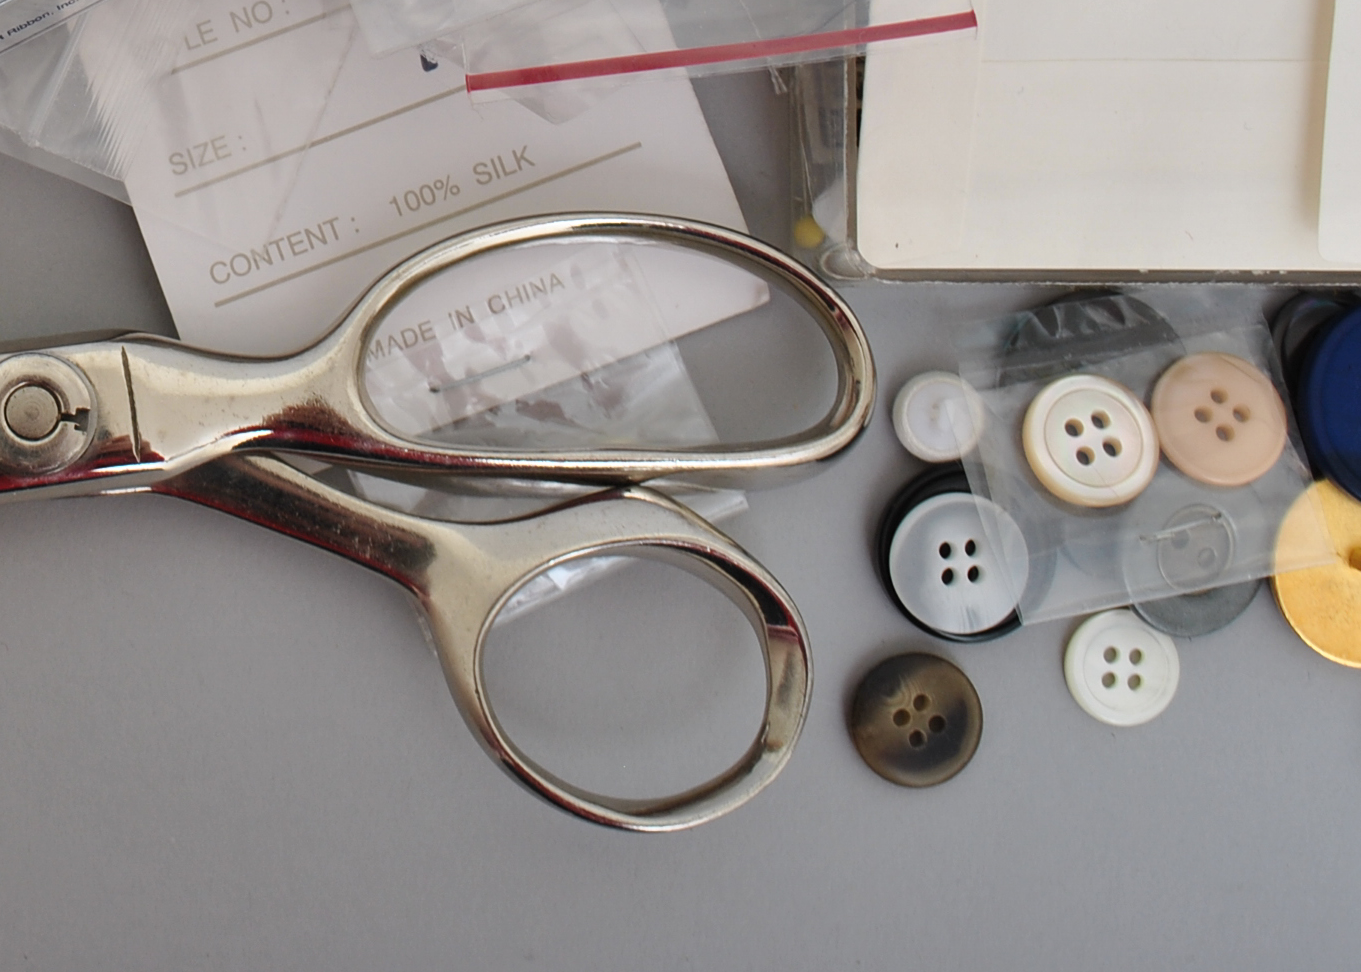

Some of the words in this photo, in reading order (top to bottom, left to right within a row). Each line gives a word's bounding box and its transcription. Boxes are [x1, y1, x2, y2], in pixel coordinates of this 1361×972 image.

[7, 10, 55, 36] Ribbon,
[387, 174, 461, 218] 100%
[472, 146, 536, 186] SILK
[366, 320, 436, 363] MADE
[448, 305, 476, 331] IN
[487, 272, 566, 316] CHINA
